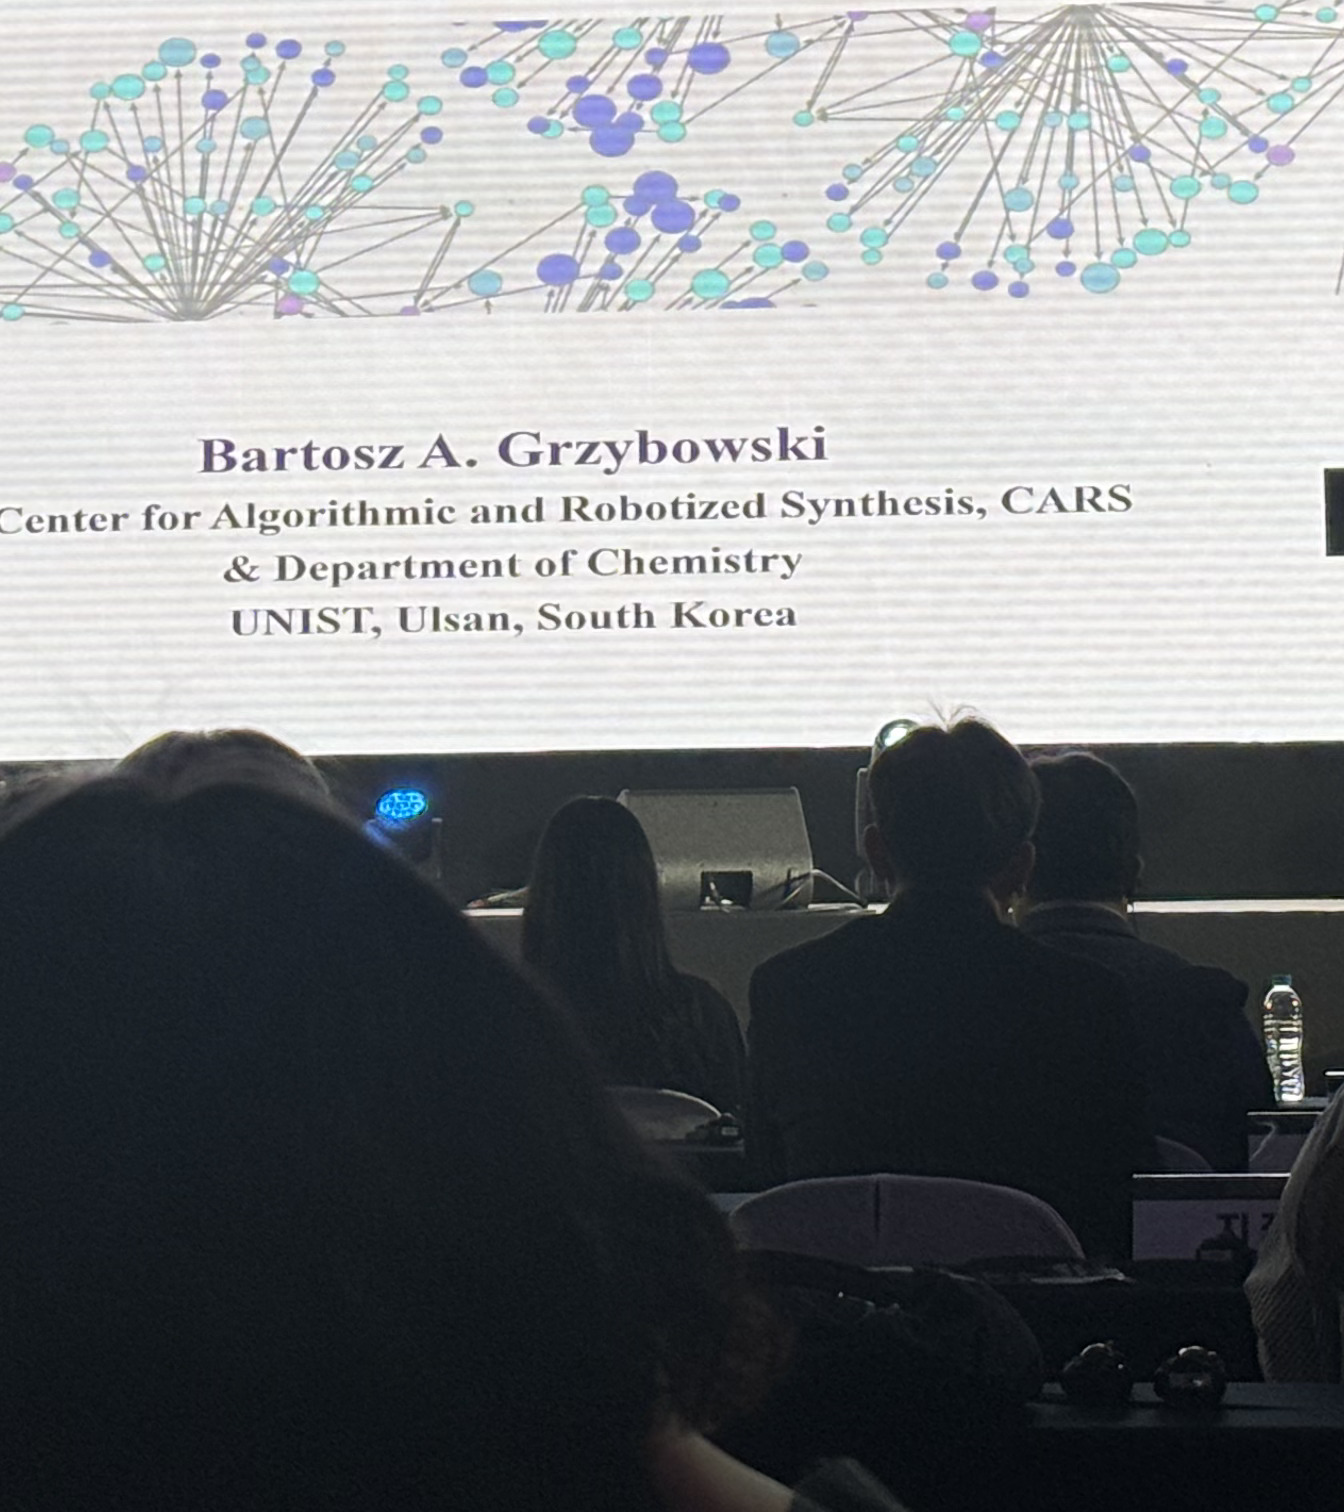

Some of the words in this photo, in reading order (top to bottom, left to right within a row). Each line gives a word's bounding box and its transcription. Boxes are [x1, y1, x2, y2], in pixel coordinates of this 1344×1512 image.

[200, 438, 405, 473] Bartosz
[418, 434, 477, 469] A.
[498, 425, 826, 476] Grzybowski
[143, 504, 202, 531] for
[211, 497, 456, 535] Algorithmic
[470, 496, 544, 524] and
[561, 492, 766, 522] Robotized
[781, 488, 987, 525] Synthesis,
[1001, 485, 1132, 514] CARS
[223, 556, 259, 583] &
[276, 554, 519, 588] Department
[534, 549, 578, 577] of
[587, 546, 802, 580] Chemistry
[232, 607, 382, 637] UNIST,
[399, 606, 524, 634] Ulsan,
[537, 602, 655, 631] South
[674, 601, 796, 628] Korea
